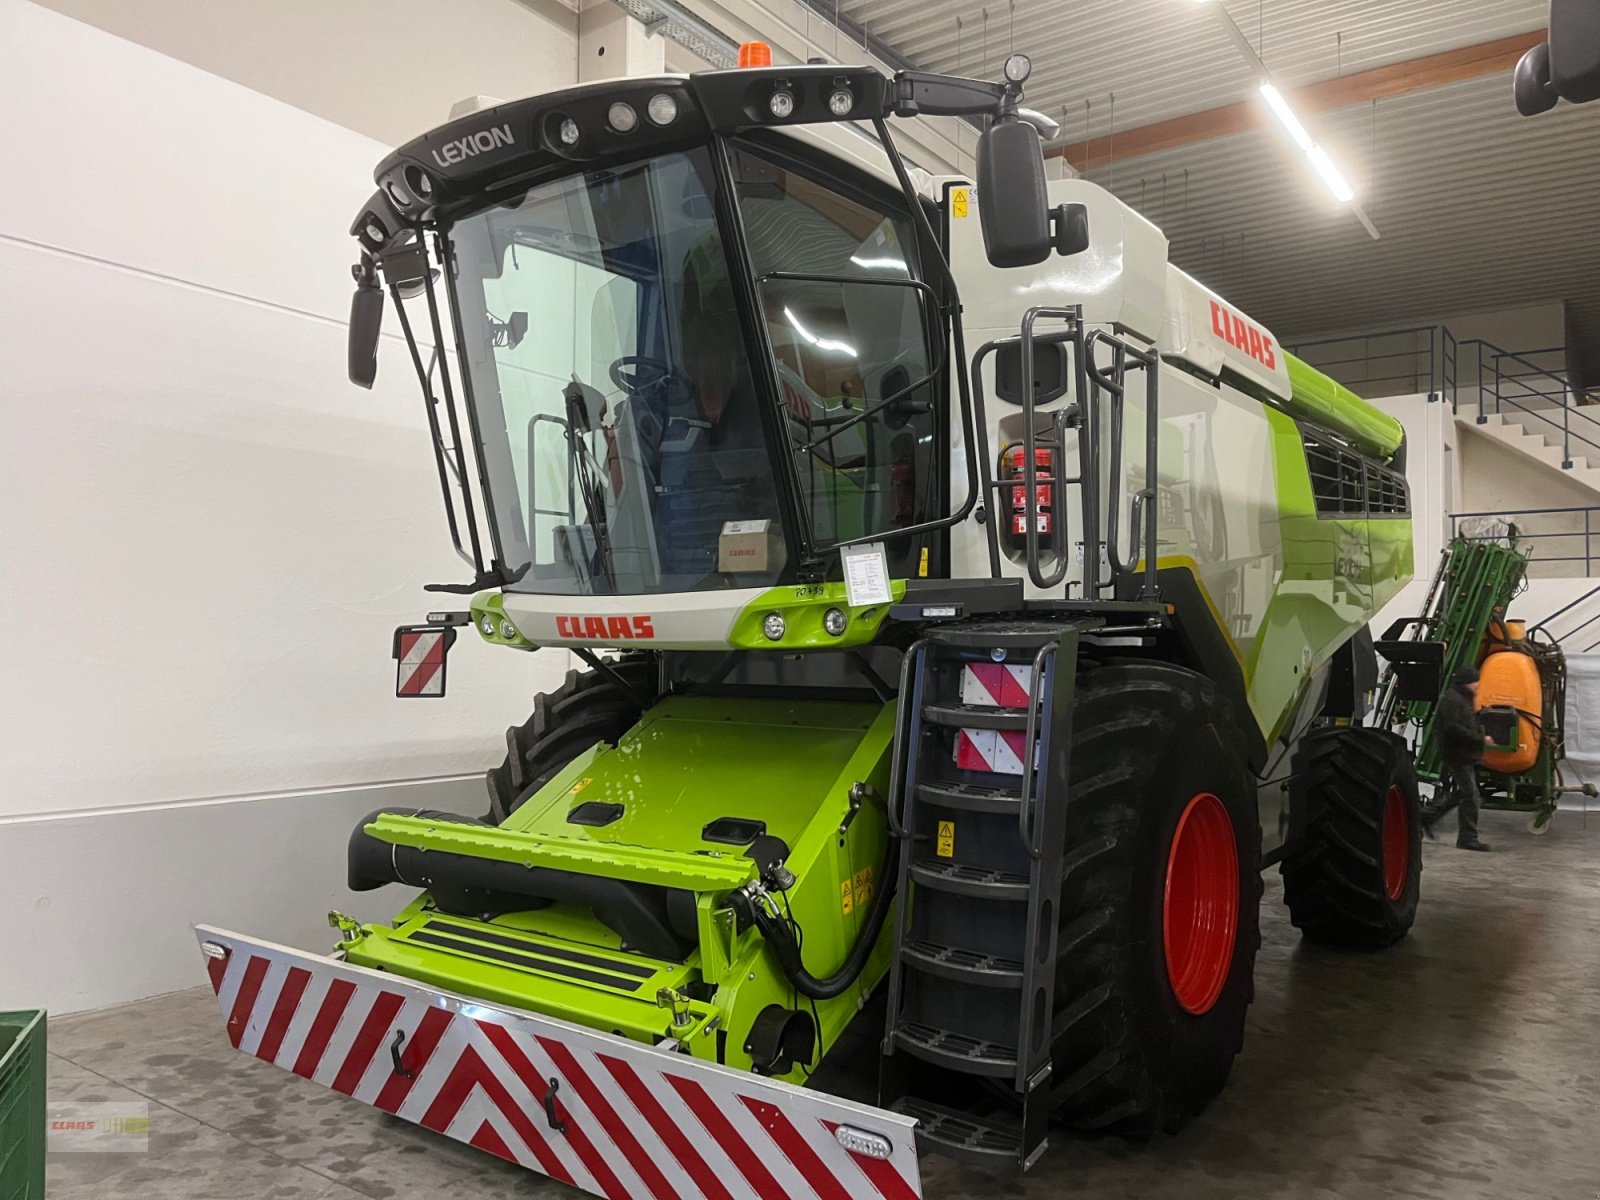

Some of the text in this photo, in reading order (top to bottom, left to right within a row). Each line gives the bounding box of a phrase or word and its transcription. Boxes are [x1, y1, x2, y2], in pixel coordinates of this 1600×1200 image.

[431, 123, 515, 168] LEXION
[1209, 299, 1276, 372] CLAAS
[729, 549, 757, 557] CLAAS
[555, 615, 655, 639] CLAAS
